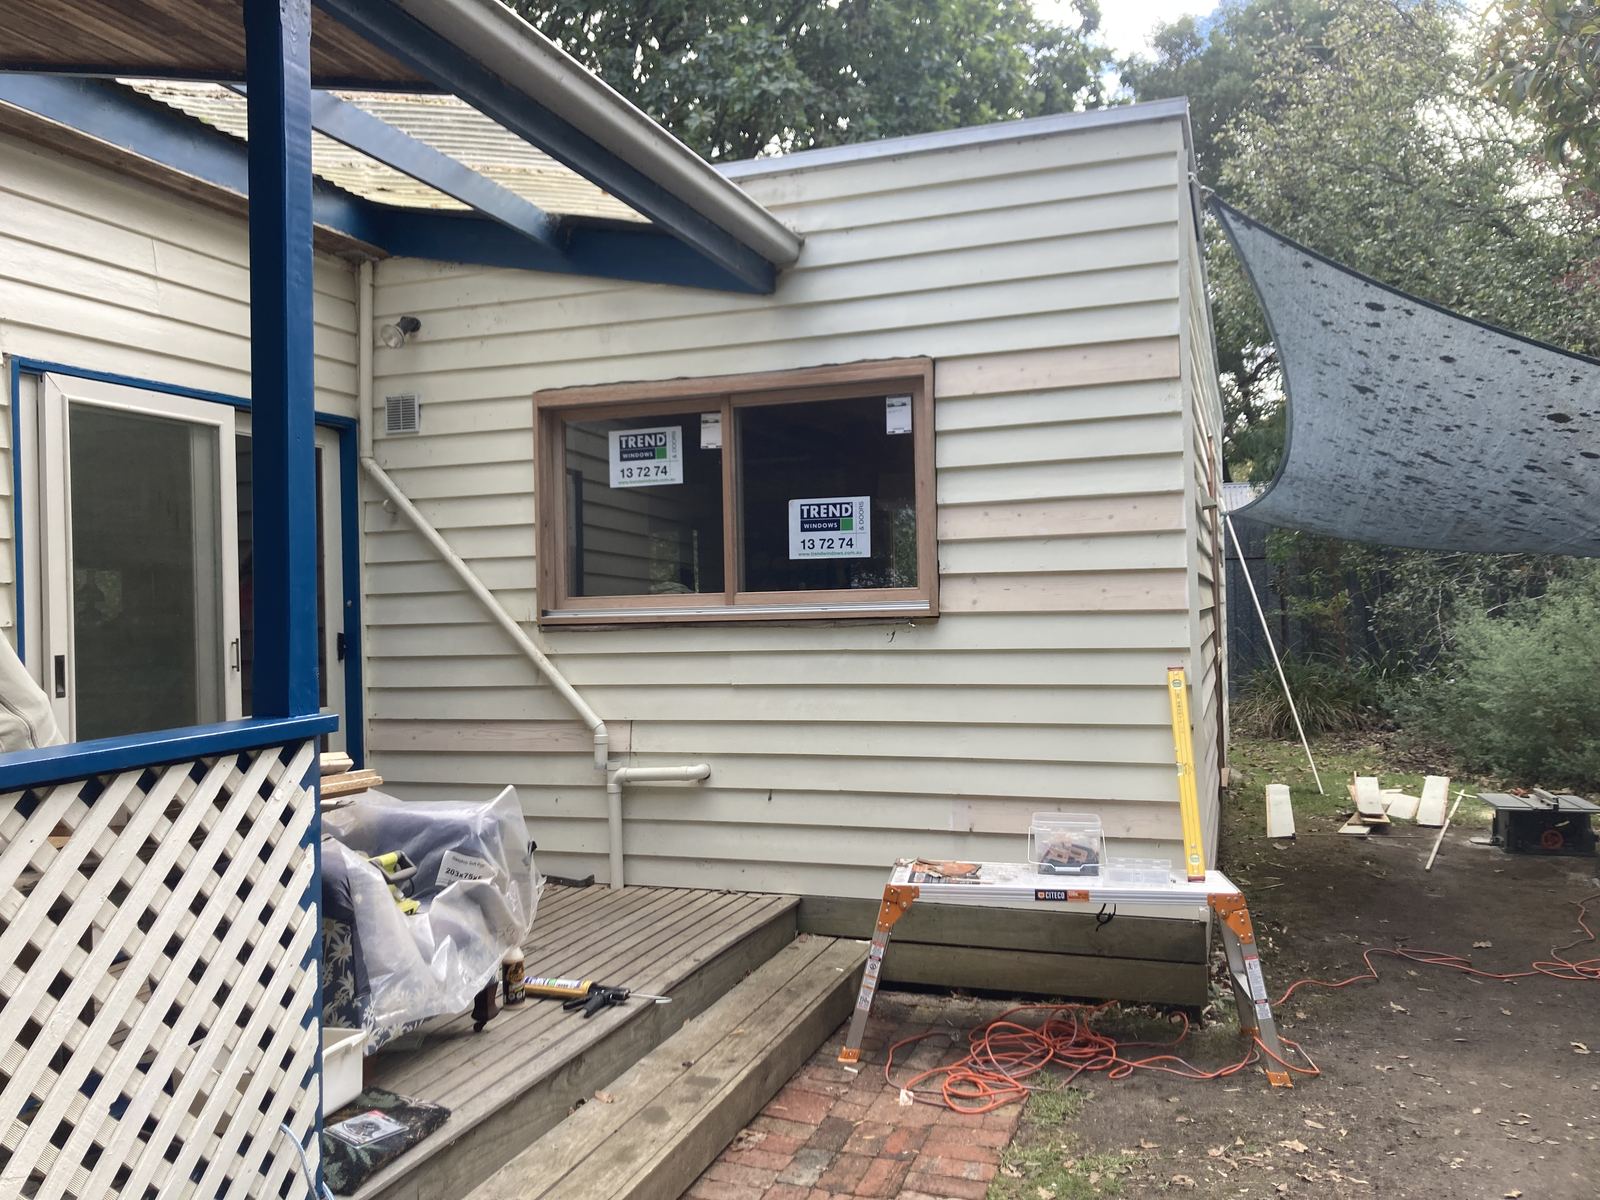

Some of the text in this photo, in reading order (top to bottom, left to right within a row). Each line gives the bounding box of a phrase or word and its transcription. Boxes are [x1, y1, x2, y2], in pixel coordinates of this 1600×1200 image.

[620, 433, 666, 449] TREND
[622, 451, 654, 459] WINDOWS
[620, 465, 668, 479] 13 72 74
[801, 503, 852, 518] TREND
[800, 537, 854, 550] 13 72 74
